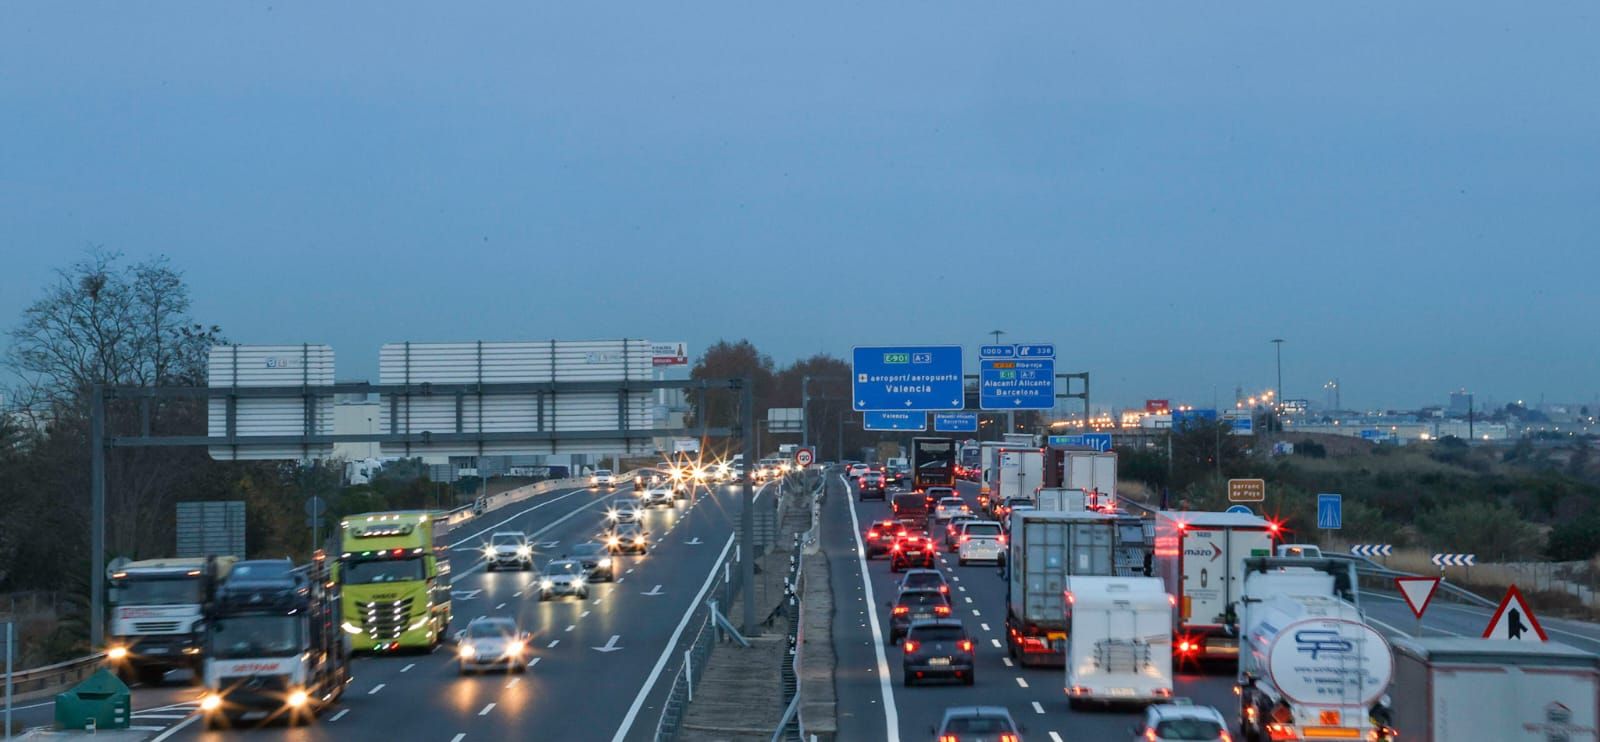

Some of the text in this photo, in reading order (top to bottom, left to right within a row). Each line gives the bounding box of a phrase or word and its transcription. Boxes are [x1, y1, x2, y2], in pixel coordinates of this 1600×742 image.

[886, 354, 931, 362] E-901 A-3
[885, 384, 932, 393] Valencia
[996, 388, 1039, 396] Barcelona
[800, 454, 810, 462] 120
[1184, 548, 1212, 556] mazo
